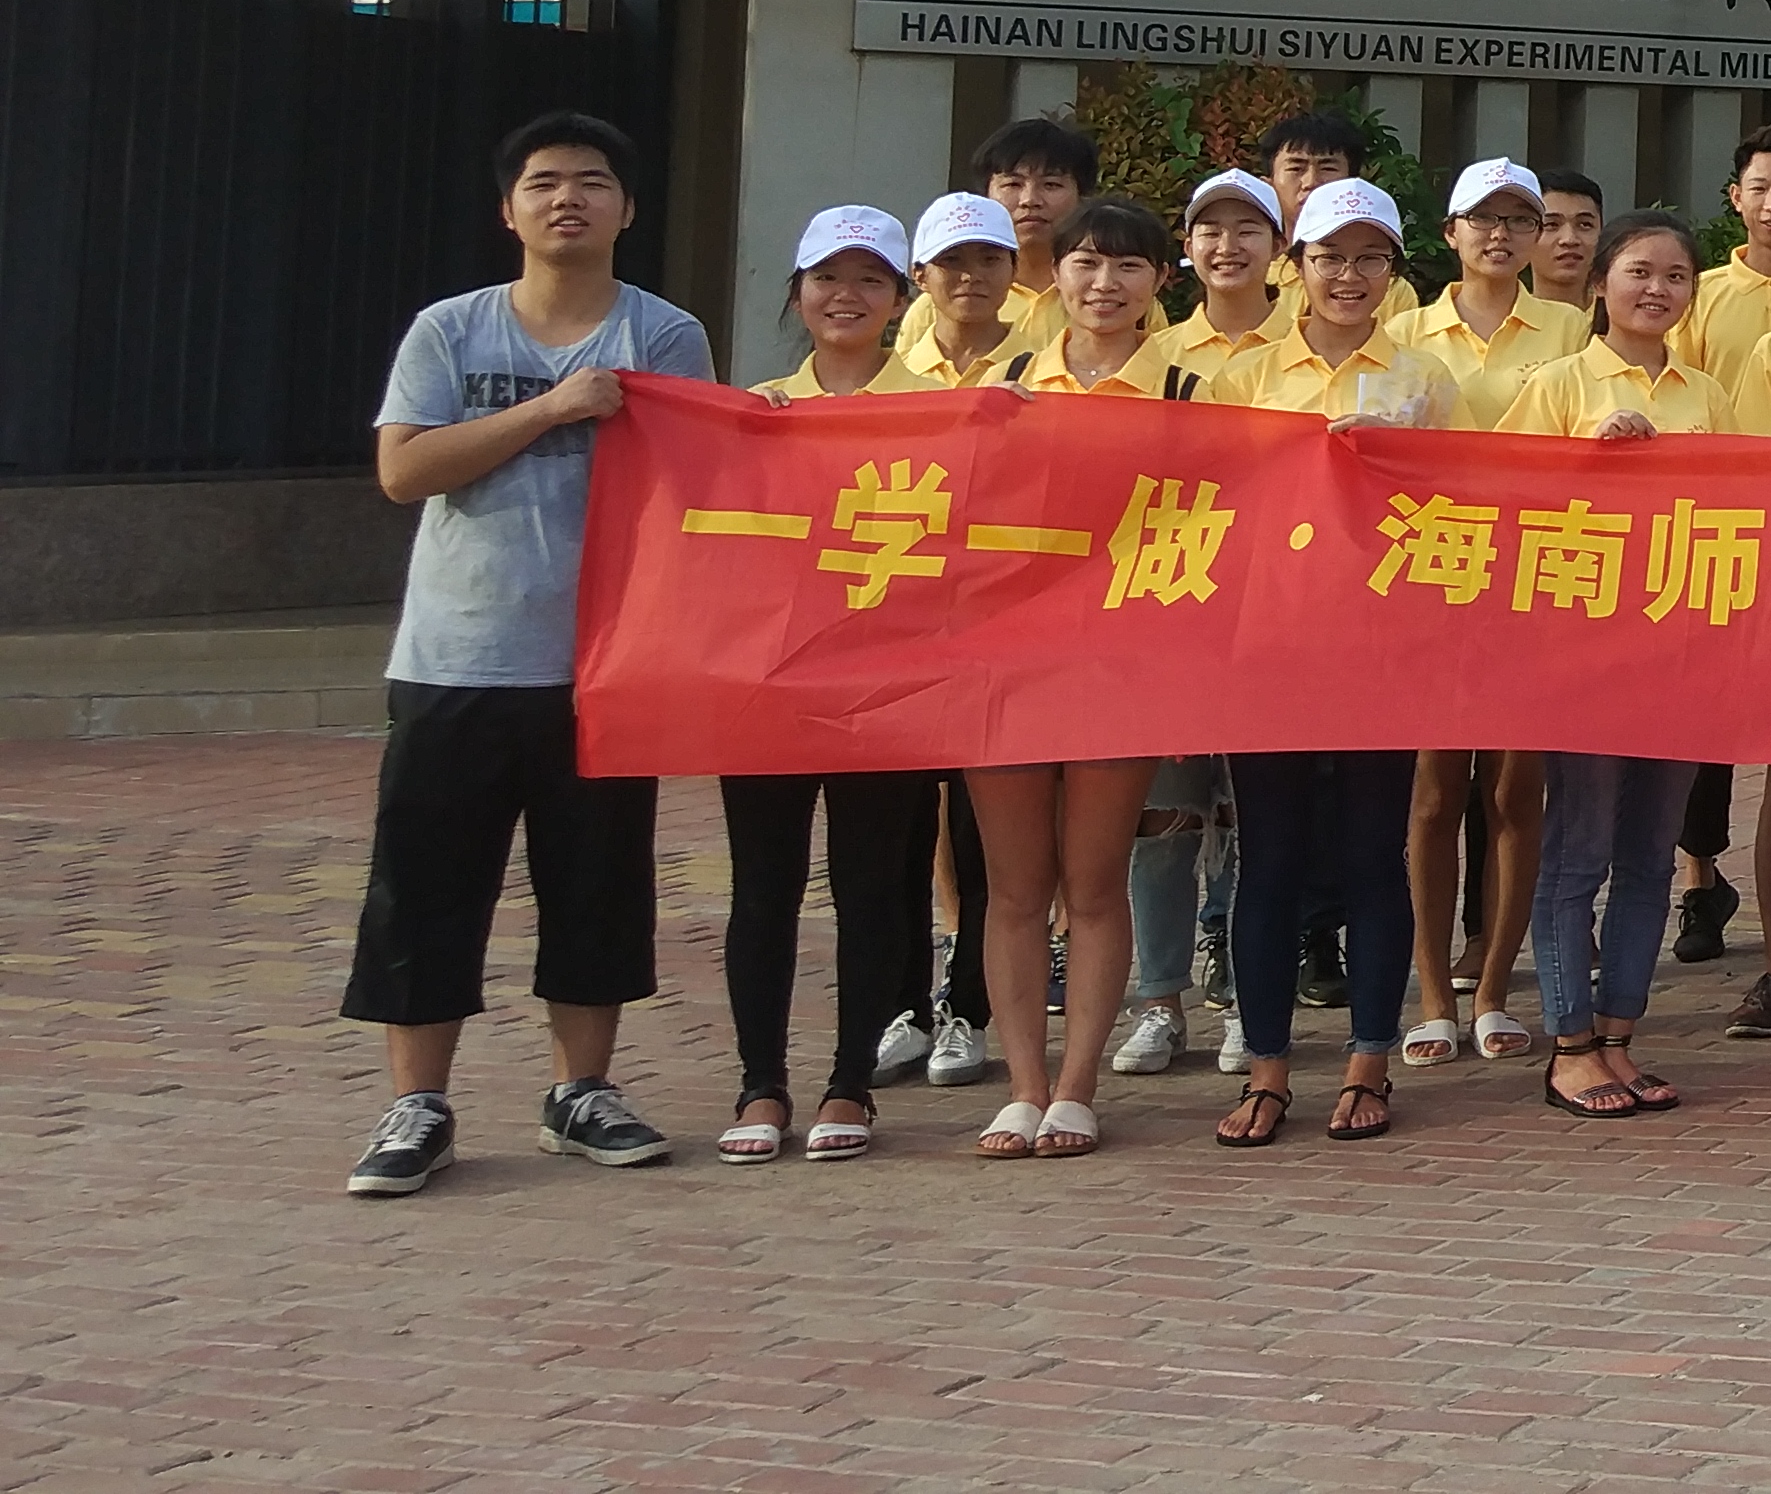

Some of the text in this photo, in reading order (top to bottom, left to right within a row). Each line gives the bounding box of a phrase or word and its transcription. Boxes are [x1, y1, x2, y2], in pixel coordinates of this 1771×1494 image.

[900, 11, 1064, 48] HAINAN
[1076, 19, 1266, 57] LINGSHUI
[1278, 30, 1424, 65] SIYUAN
[1434, 37, 1711, 78] EXPERIMENTAL
